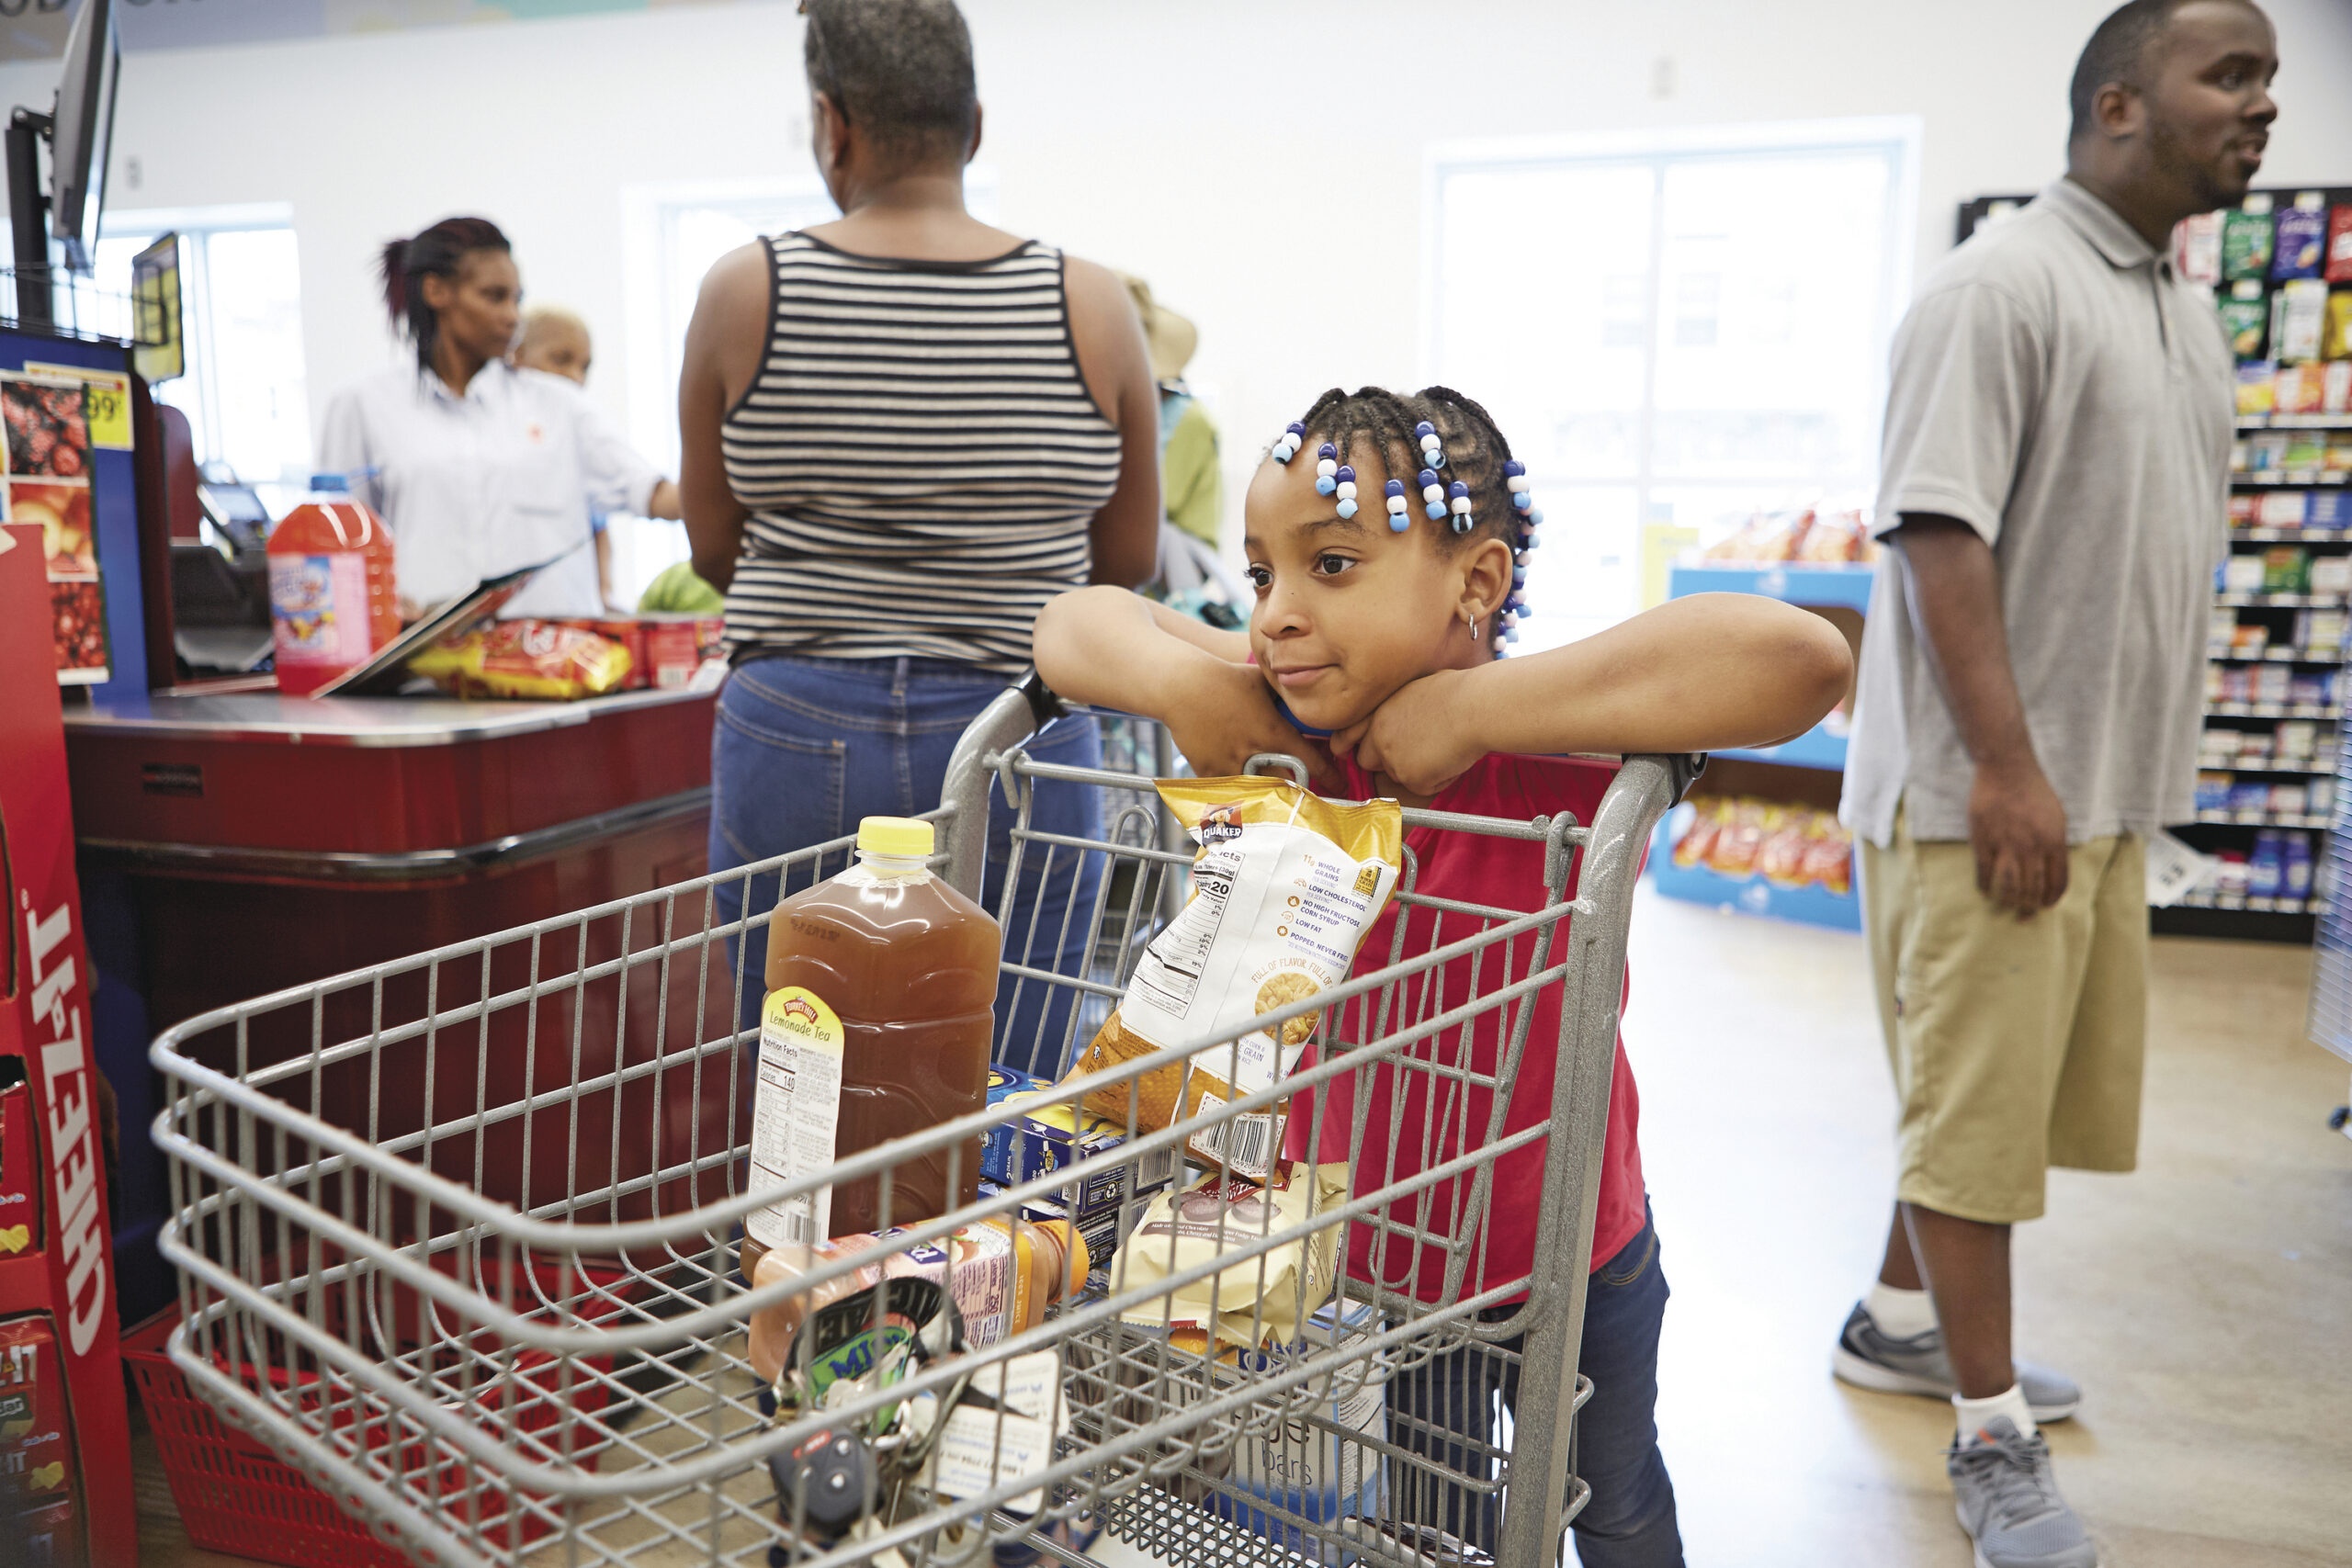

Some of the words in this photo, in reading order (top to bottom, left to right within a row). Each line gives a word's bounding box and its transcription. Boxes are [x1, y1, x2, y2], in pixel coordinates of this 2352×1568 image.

[1204, 827, 1241, 839] QUAKER
[1315, 868, 1340, 882] GRAINS
[1318, 862, 1340, 874] WHOLE
[1308, 884, 1323, 894] LOW
[1300, 906, 1317, 918] CORN
[1318, 912, 1340, 926] SYRUP
[1303, 899, 1314, 908] NO
[1314, 902, 1330, 914] HIGH
[1330, 908, 1361, 928] FRUCTOSE
[1295, 919, 1310, 929] LOW
[1310, 923, 1322, 933] FAT
[1317, 944, 1337, 957] NEVER
[1251, 967, 1270, 984] FULL
[1269, 960, 1278, 971] OF
[1308, 963, 1323, 979] FULL
[1323, 976, 1332, 986] OF
[770, 1010, 811, 1036] Lemonade
[814, 1026, 831, 1042] Tea
[763, 1038, 783, 1051] Nutrition
[784, 1044, 797, 1058] Facts
[1243, 1047, 1264, 1063] GRAIN
[784, 1076, 796, 1089] 140
[989, 1258, 999, 1287] Calories
[989, 1293, 1000, 1314] 250
[1261, 1439, 1313, 1485] bars
